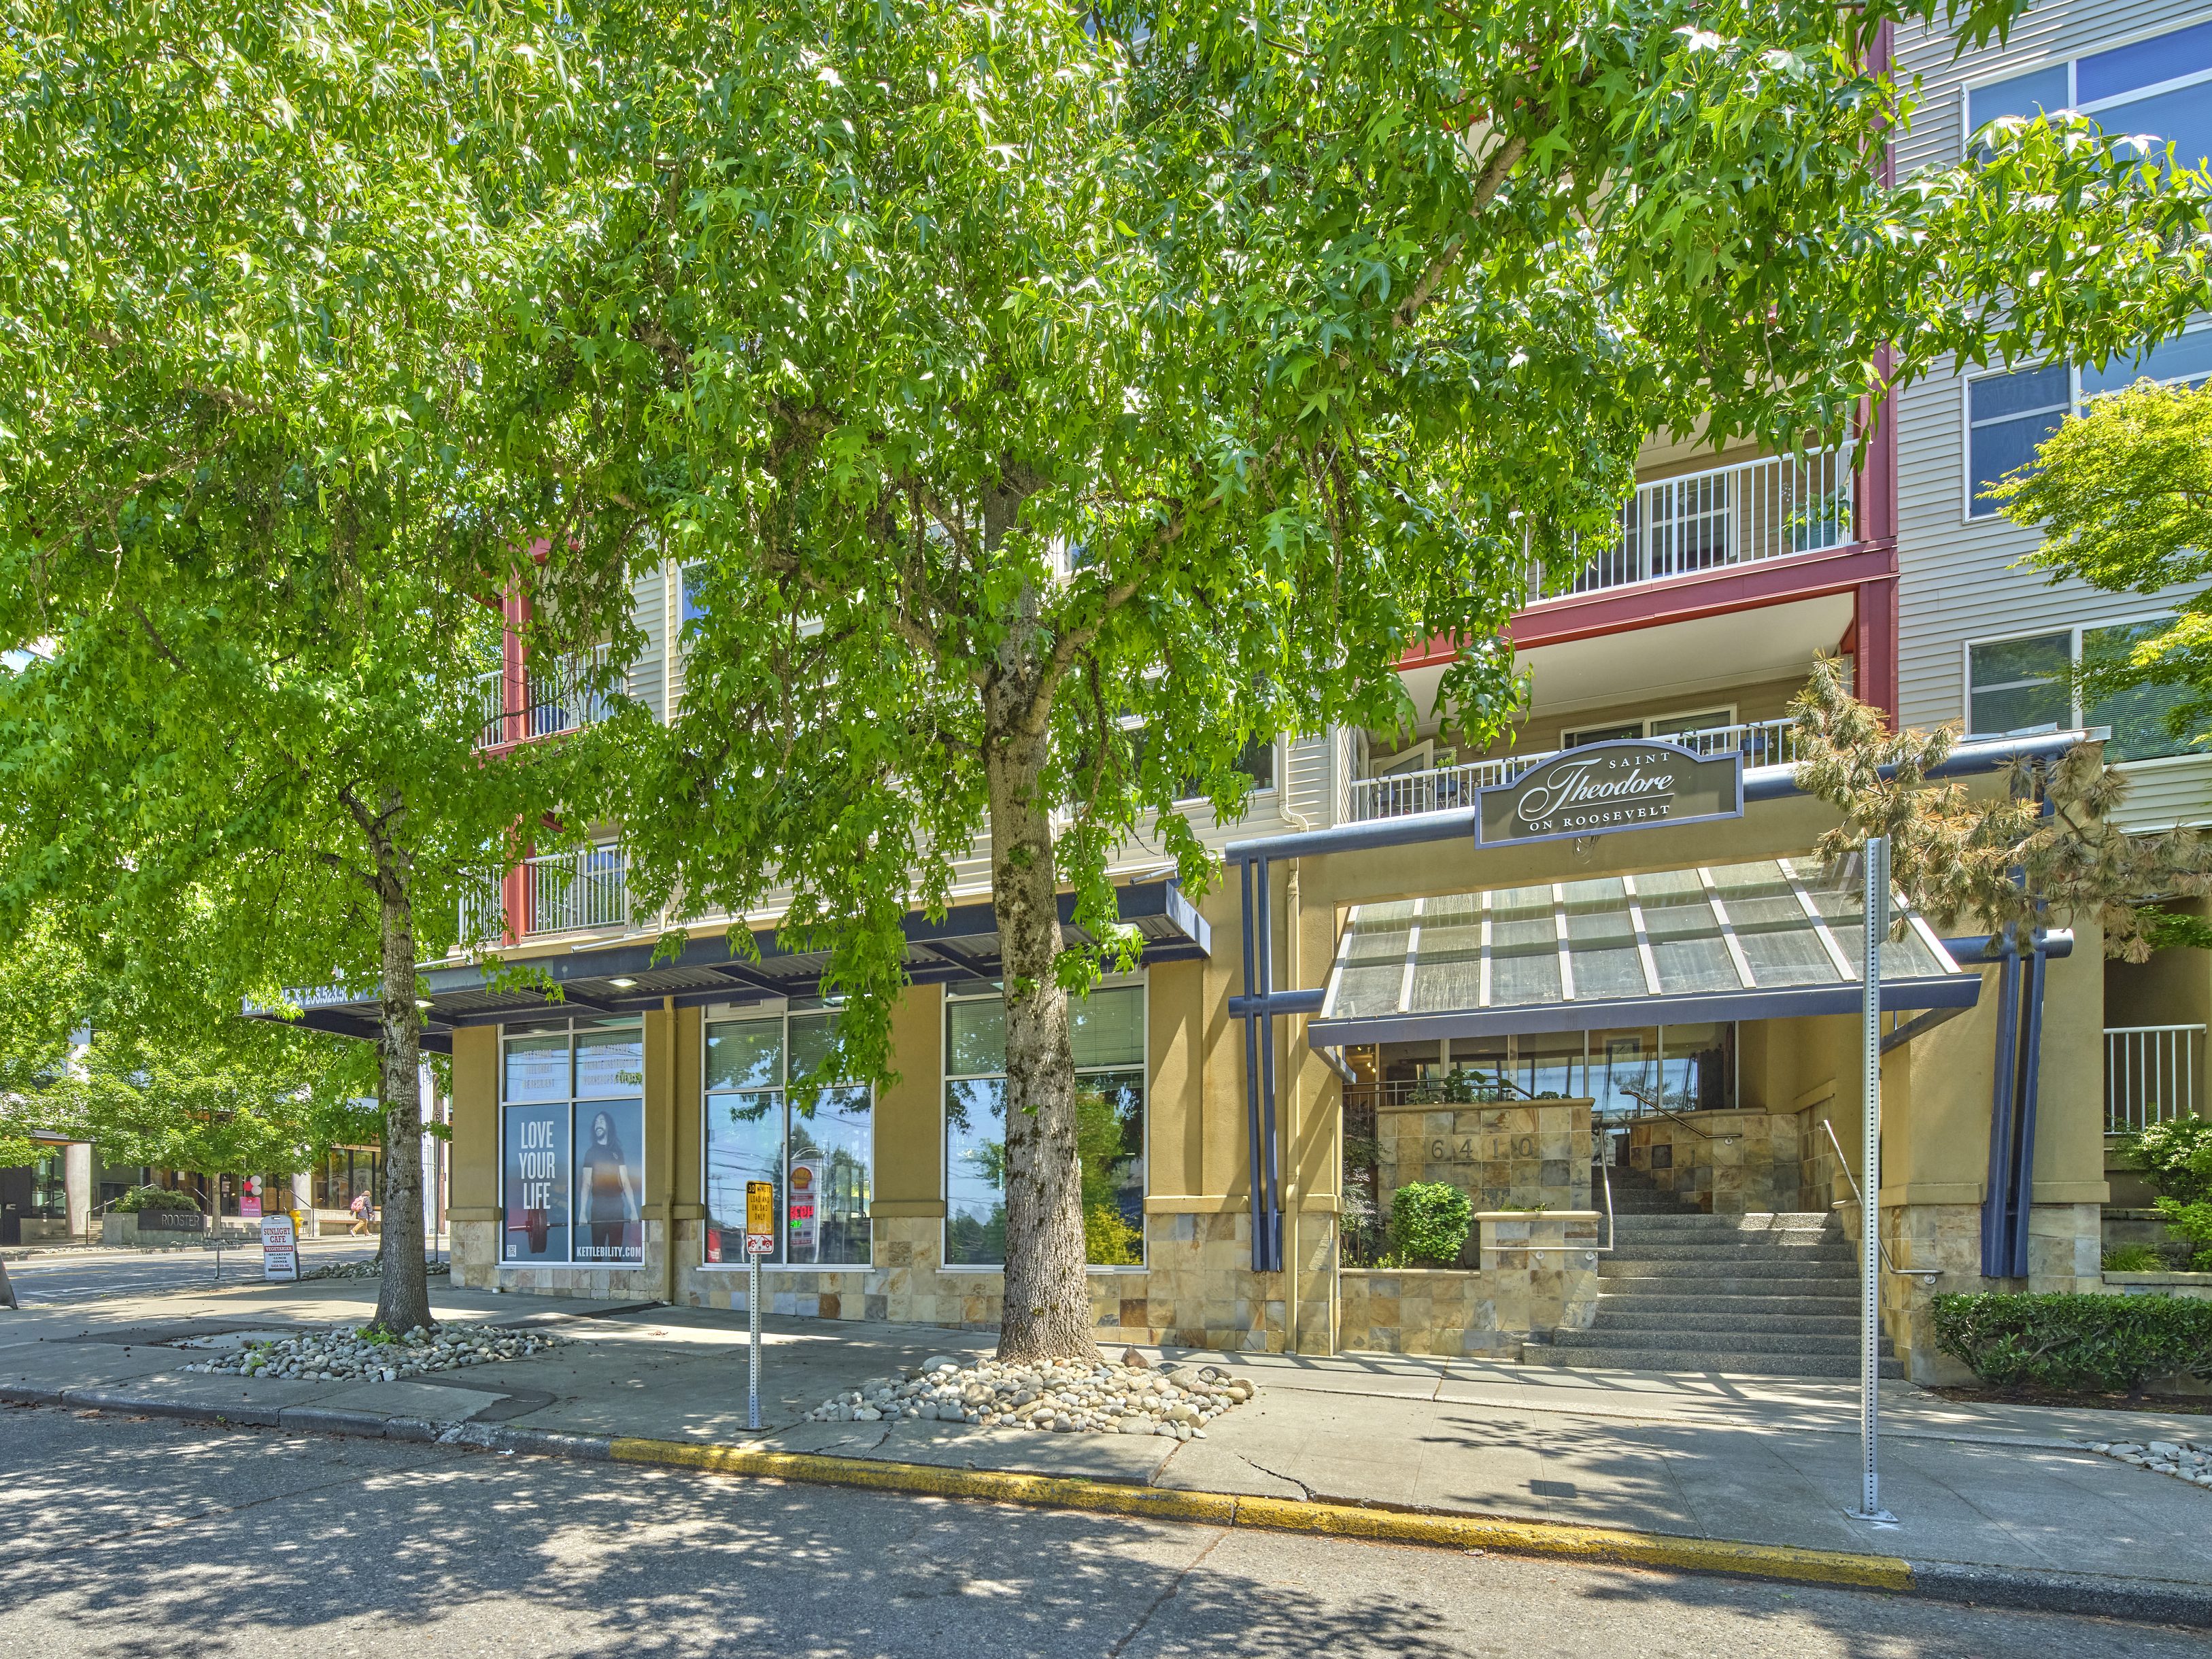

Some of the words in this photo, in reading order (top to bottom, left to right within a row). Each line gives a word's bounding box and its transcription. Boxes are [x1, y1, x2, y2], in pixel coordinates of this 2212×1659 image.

[1609, 752, 1670, 769] SAINT
[1517, 757, 1675, 821] Theodore
[1529, 820, 1552, 832] ON
[1563, 805, 1670, 827] ROOSEVELT
[619, 1072, 637, 1082] EVENTS
[521, 1121, 554, 1149] LOVE
[1431, 1137, 1533, 1159] 6410
[519, 1151, 556, 1180] YOUR
[523, 1182, 551, 1210] LIFE
[162, 1214, 199, 1227] ROOSTER
[264, 1227, 290, 1235] SUNLIGHT
